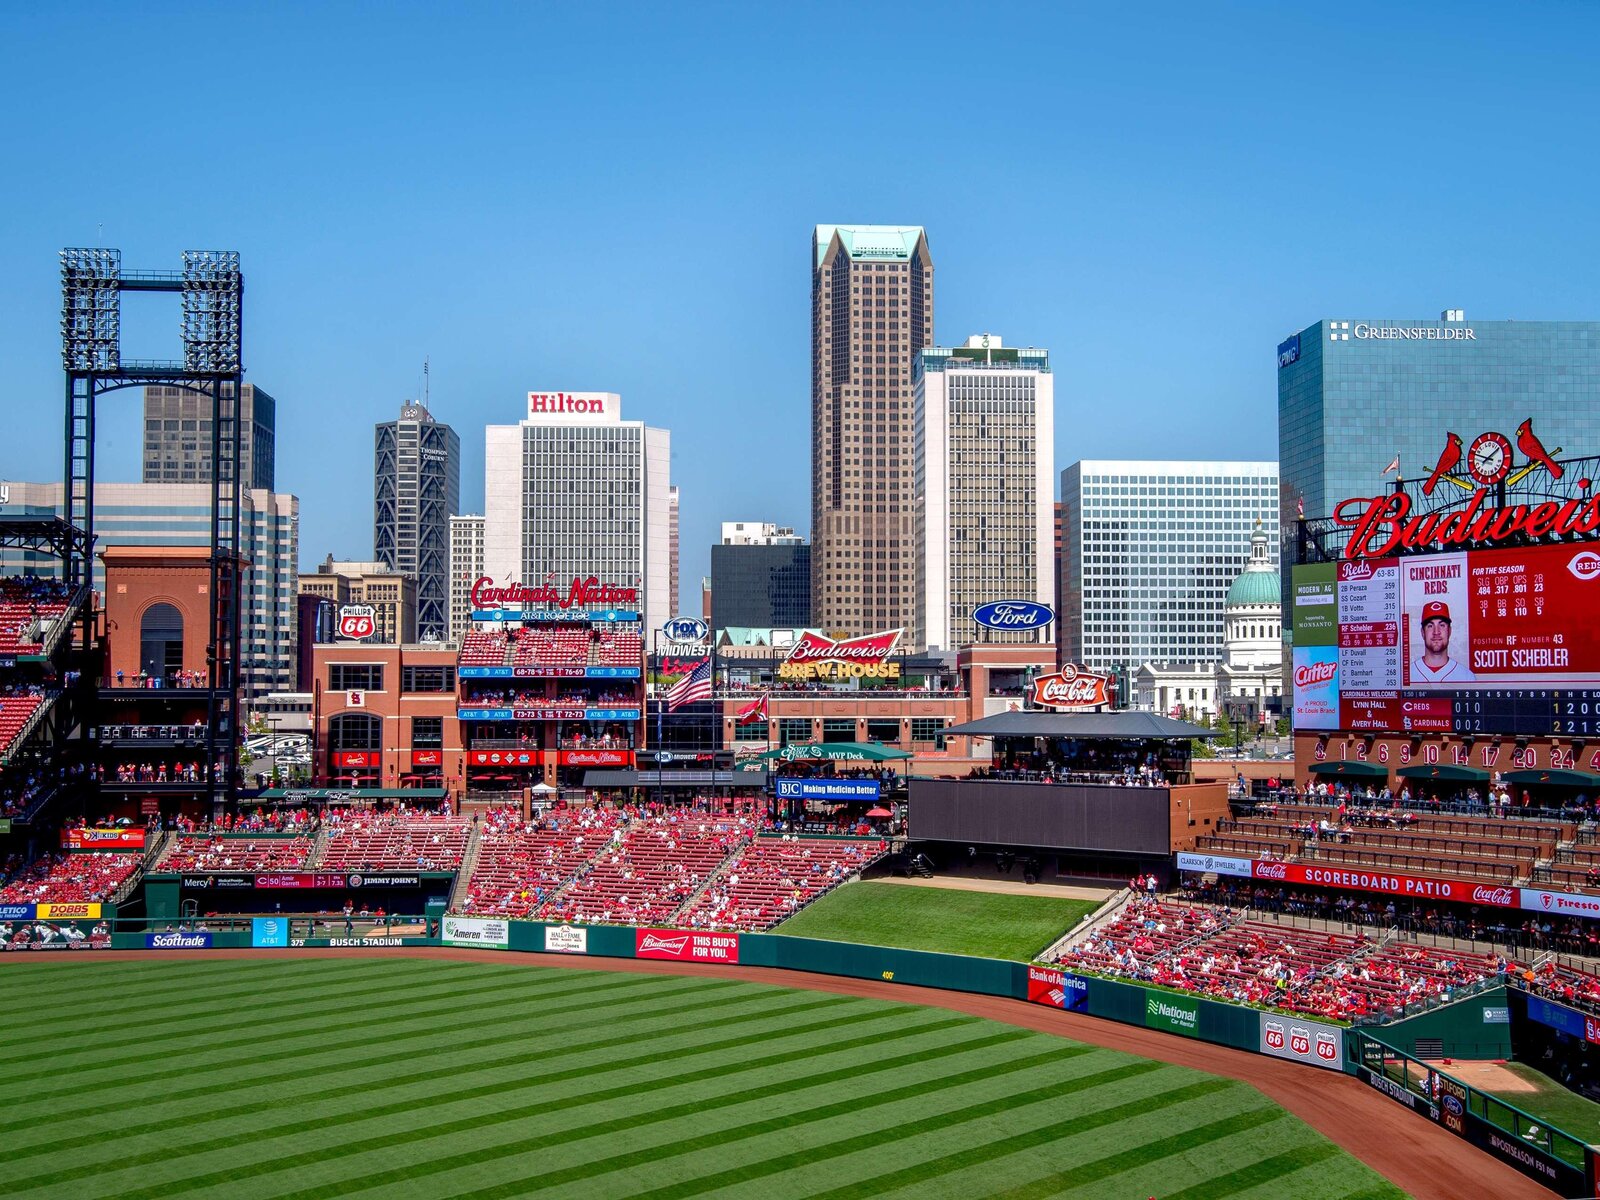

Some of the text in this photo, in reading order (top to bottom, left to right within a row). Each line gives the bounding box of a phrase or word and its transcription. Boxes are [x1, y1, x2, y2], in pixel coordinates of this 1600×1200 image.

[1354, 324, 1476, 340] GREENSFELDER
[1278, 347, 1296, 367] KPMG
[531, 393, 604, 413] Hilton
[1476, 459, 1502, 476] CARDINALS
[1342, 559, 1395, 580] Reds 63-83
[1409, 564, 1461, 581] CINCINNATI
[1472, 565, 1525, 576] FOR THE SEASON
[1477, 574, 1544, 587] SLG OBP OPS 2B
[471, 577, 637, 609] Cardinals Nation
[1298, 586, 1320, 594] MODERN
[1424, 581, 1448, 595] REDS
[1477, 583, 1544, 595] .484 .317 .801 23
[1479, 596, 1544, 609] 3B BB SO SB
[344, 608, 371, 616] PHILLIPS
[520, 611, 541, 620] AT&T
[990, 604, 1038, 625] Ford
[1497, 607, 1527, 617] 38 110
[344, 618, 369, 633] 66
[672, 621, 698, 638] FOX
[1350, 624, 1373, 632] Schebler
[1506, 636, 1517, 646] RF
[1521, 636, 1549, 644] NUMBER
[1553, 634, 1563, 644] 43
[657, 645, 713, 656] MIDWEST
[783, 640, 899, 659] Budweiser
[1474, 648, 1568, 668] SCOTT SCHEBLER
[780, 662, 900, 678] BREW HOUSE
[1294, 662, 1337, 686] Cutter
[1043, 678, 1099, 701] Coca-Cola
[1413, 719, 1450, 727] CARDINALS
[829, 752, 864, 760] MVP Deck
[1339, 742, 1574, 770] 1 2 6 9 10 14 17 20 24
[781, 783, 799, 795] BJC
[803, 785, 876, 795] Making Medicine Better
[1181, 858, 1236, 870] CLARKSON JEWELERS
[1256, 862, 1287, 879] Coca-Cola
[185, 879, 208, 888] Mercy
[364, 877, 418, 885] JIMMY JOHN'S
[1305, 868, 1451, 896] SCOREBOARD PATIO
[1473, 886, 1514, 904] Coca-Cola
[50, 905, 88, 913] DOBBS
[1557, 898, 1600, 911] Firesto
[453, 929, 481, 939] Ameren
[153, 935, 206, 947] Scottrade
[291, 939, 305, 947] 375'
[330, 938, 402, 946] BUSCH STADIUM
[643, 938, 684, 949] Budweiser
[693, 936, 737, 948] THIS BUD'S
[693, 947, 728, 958] FOR YOU.
[1030, 968, 1086, 990] Bank of America
[1159, 1003, 1196, 1021] National
[1180, 1020, 1194, 1028] Rental
[1268, 1033, 1282, 1045] 66
[1292, 1029, 1308, 1037] PHILLIPS
[1317, 1034, 1334, 1043] PHILLIPS
[1293, 1038, 1307, 1051] 66
[1319, 1044, 1333, 1056] 66
[1371, 1073, 1415, 1108] BUSCH STADIUM
[1439, 1077, 1466, 1100] STLFORD
[1446, 1098, 1459, 1114] Ford
[1446, 1115, 1462, 1132] .COM
[1496, 1138, 1535, 1167] POSTSEASON
[1535, 1160, 1546, 1173] FS1
